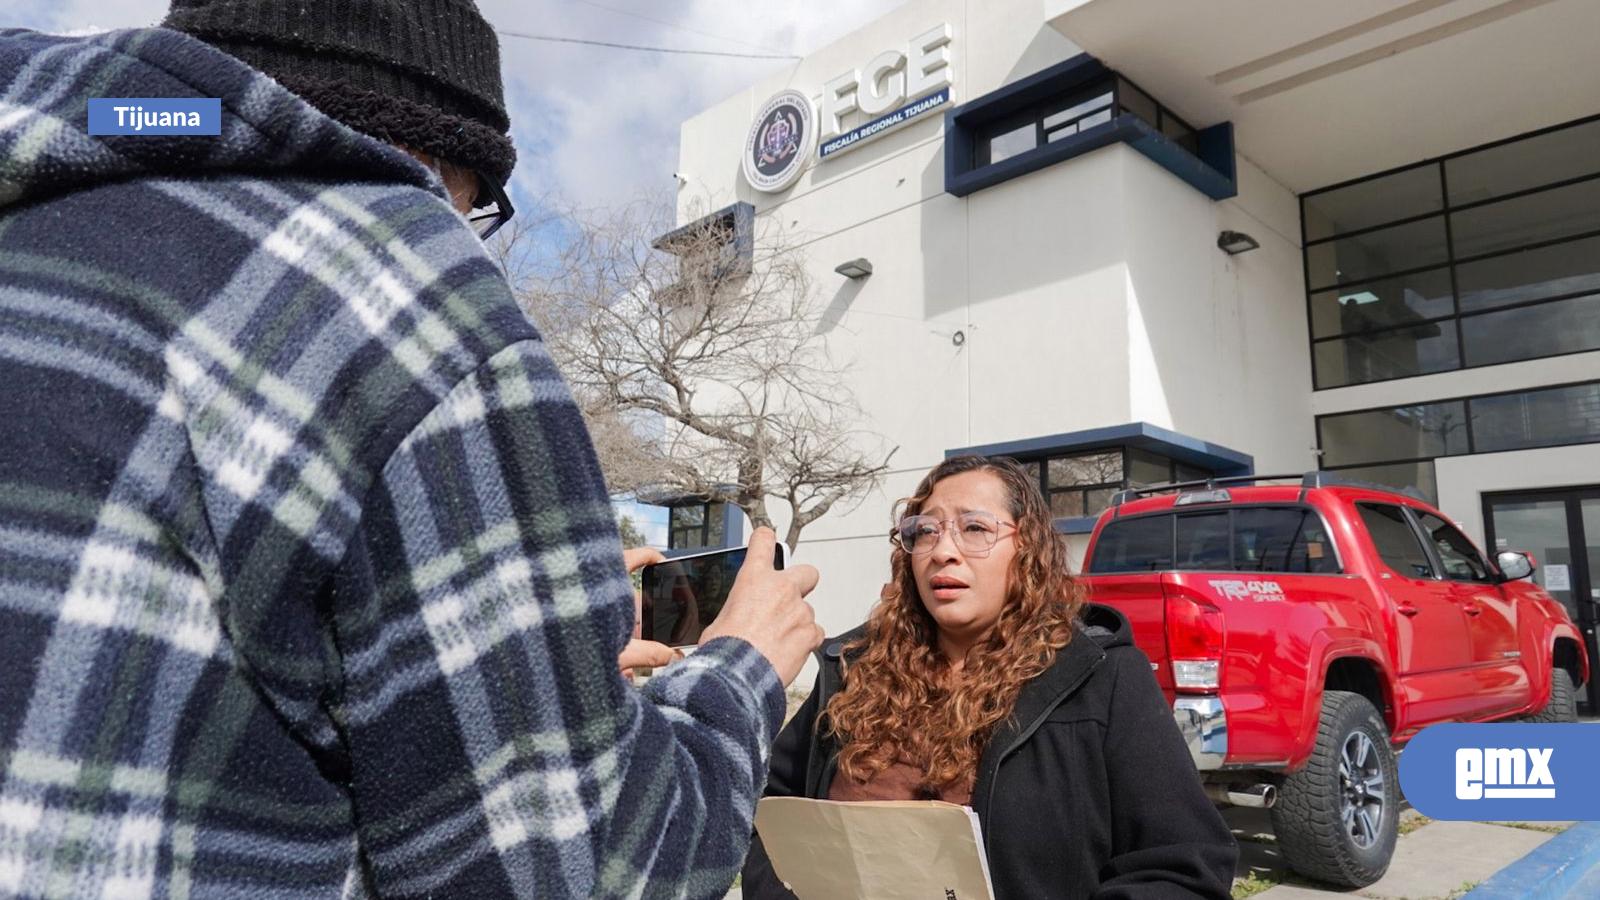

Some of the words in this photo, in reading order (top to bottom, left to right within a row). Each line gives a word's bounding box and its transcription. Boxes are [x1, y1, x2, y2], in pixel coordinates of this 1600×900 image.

[821, 23, 953, 136] FGE
[824, 132, 859, 154] FISCALÍA
[861, 113, 903, 137] REGIONAL
[904, 95, 943, 117] TIJUANA
